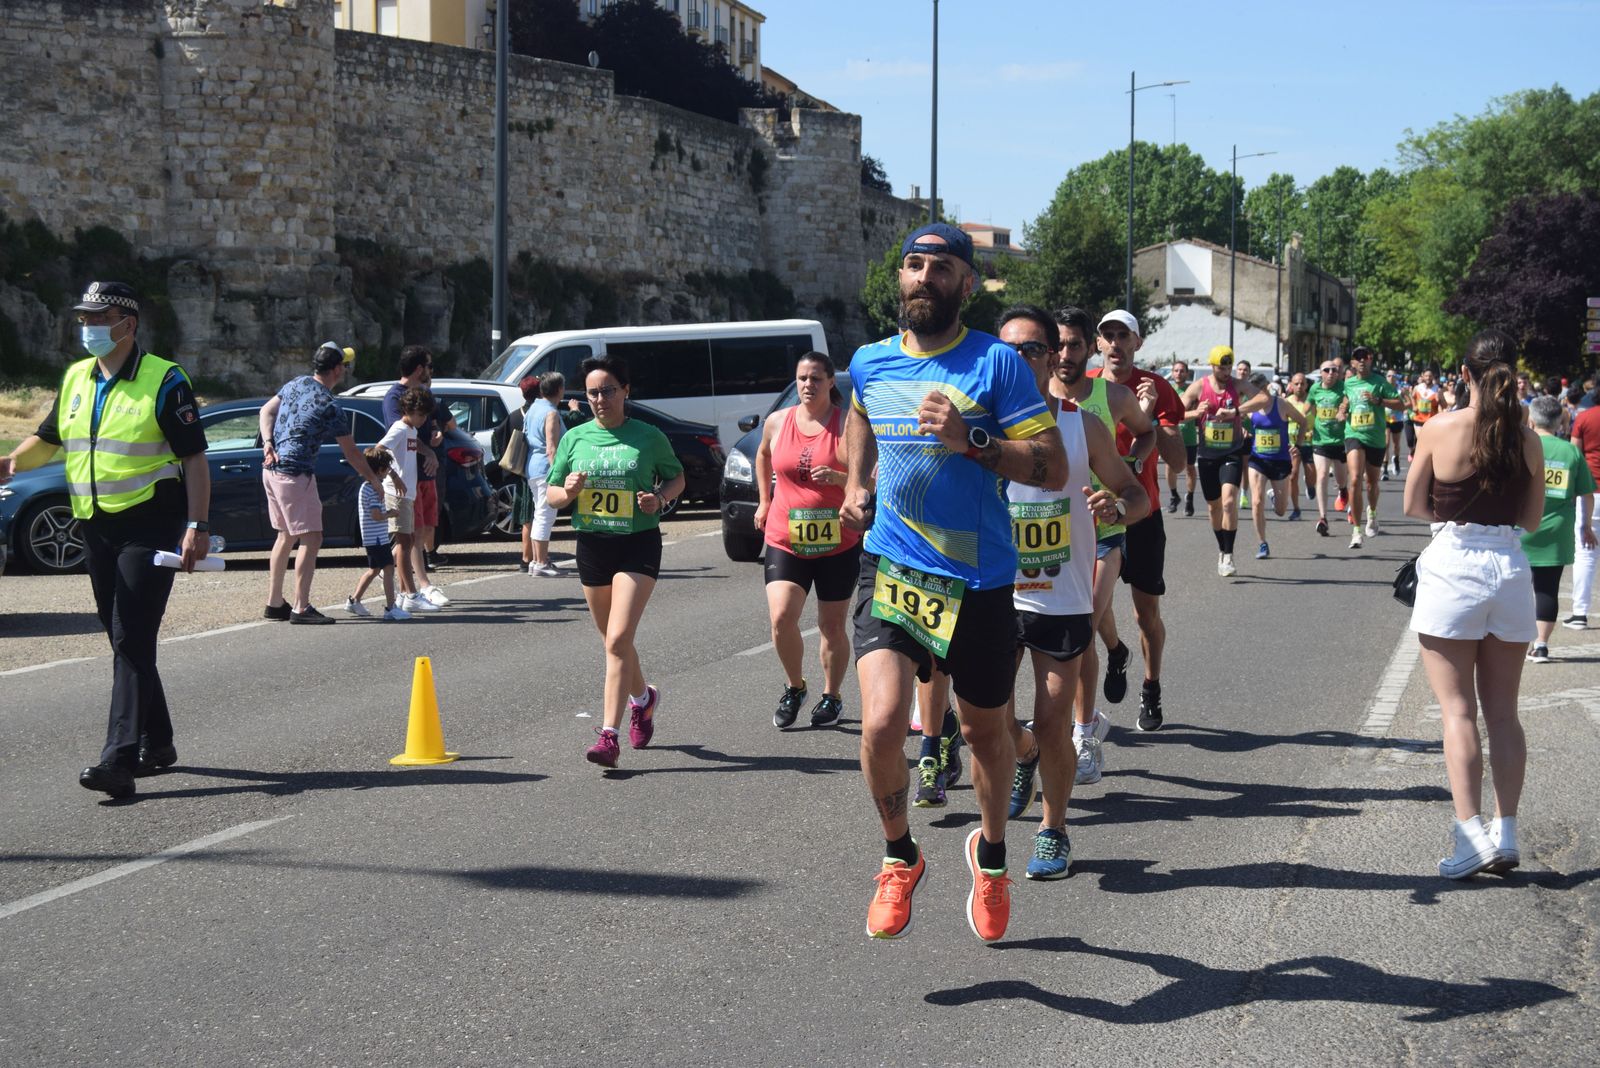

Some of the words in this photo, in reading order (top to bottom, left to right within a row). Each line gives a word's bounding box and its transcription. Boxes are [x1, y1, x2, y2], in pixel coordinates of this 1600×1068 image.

[1212, 430, 1225, 441] 81
[1260, 436, 1274, 446] 55
[578, 460, 637, 470] CERCO
[591, 491, 619, 514] 20
[1040, 509, 1063, 518] RURAL
[795, 522, 834, 542] 104
[1015, 520, 1062, 549] 100
[1042, 551, 1067, 562] RURAL
[902, 575, 923, 587] CAJA
[885, 583, 945, 630] 193
[896, 613, 916, 632] CAJA
[915, 629, 943, 652] RURAL
